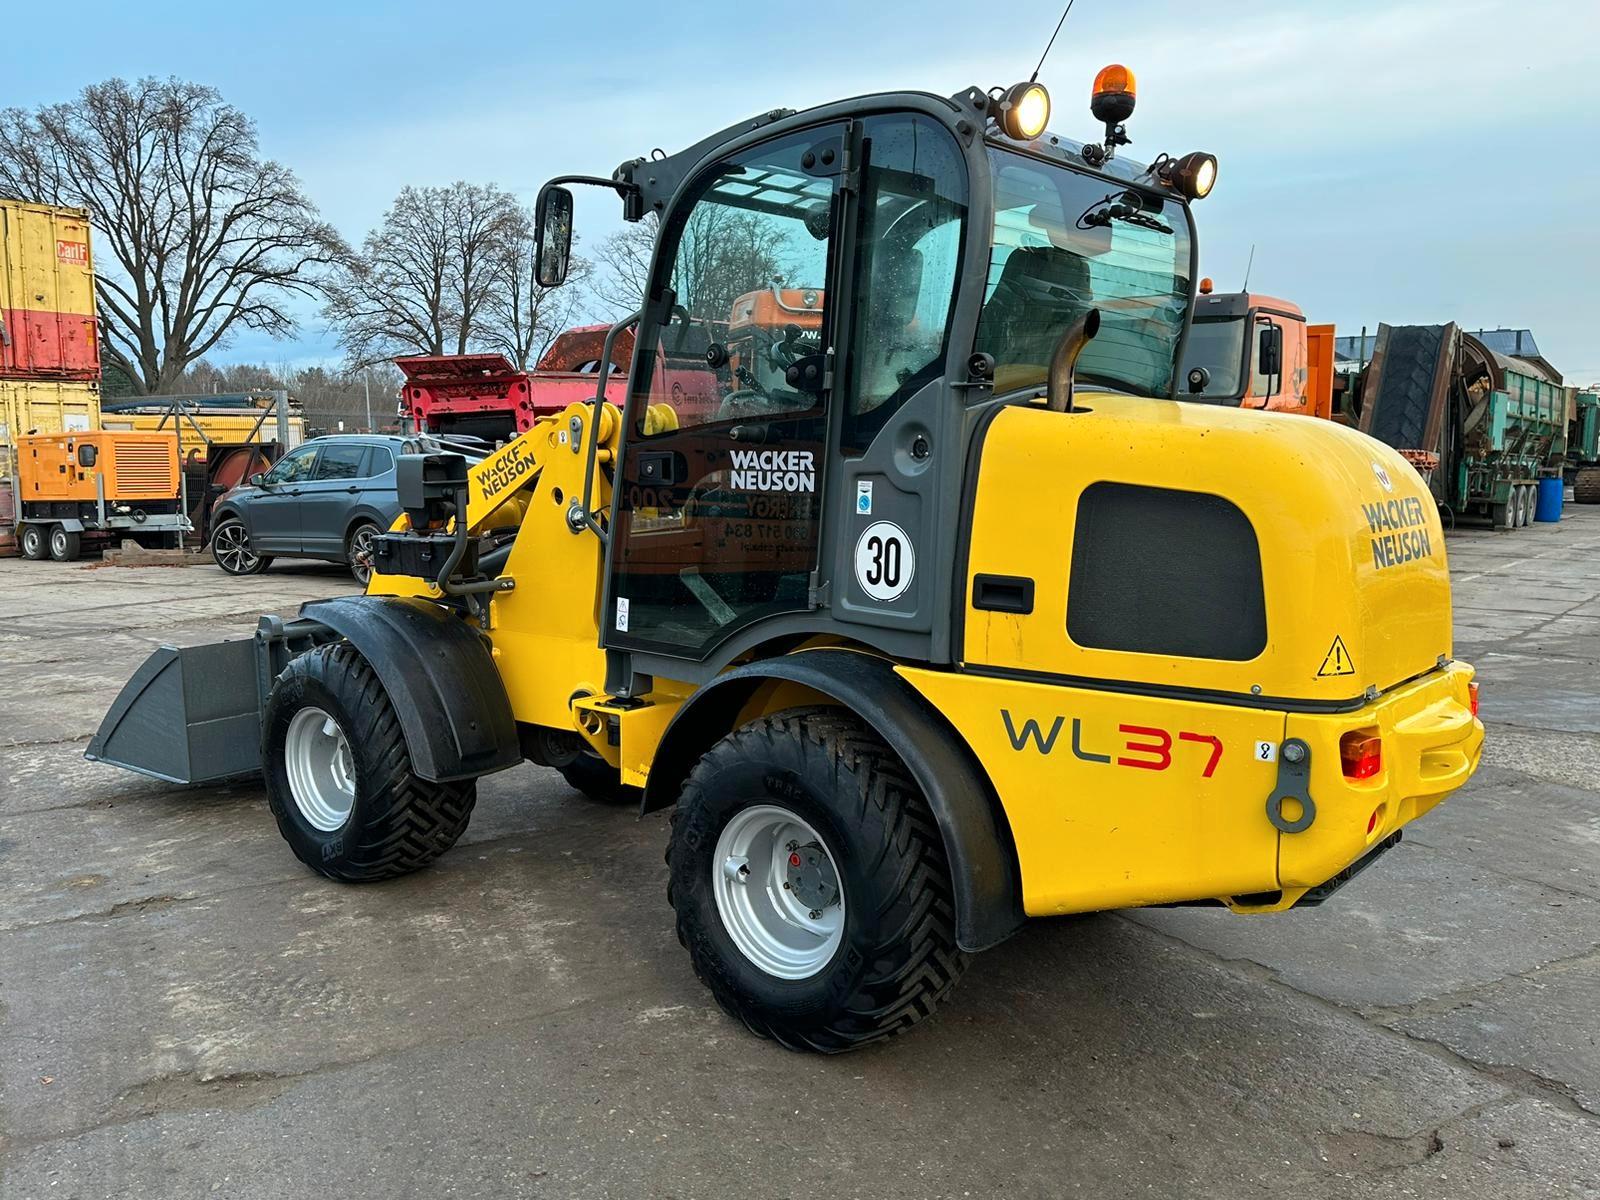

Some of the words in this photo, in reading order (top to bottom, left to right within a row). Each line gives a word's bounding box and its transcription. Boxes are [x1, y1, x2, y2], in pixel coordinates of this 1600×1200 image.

[482, 452, 536, 500] NEUSON
[729, 450, 815, 472] WACKER
[730, 470, 815, 493] NEUSON
[1362, 496, 1425, 533] WACKER
[866, 535, 902, 588] 30
[1371, 528, 1431, 570] NEUSON
[999, 709, 1224, 778] WL37
